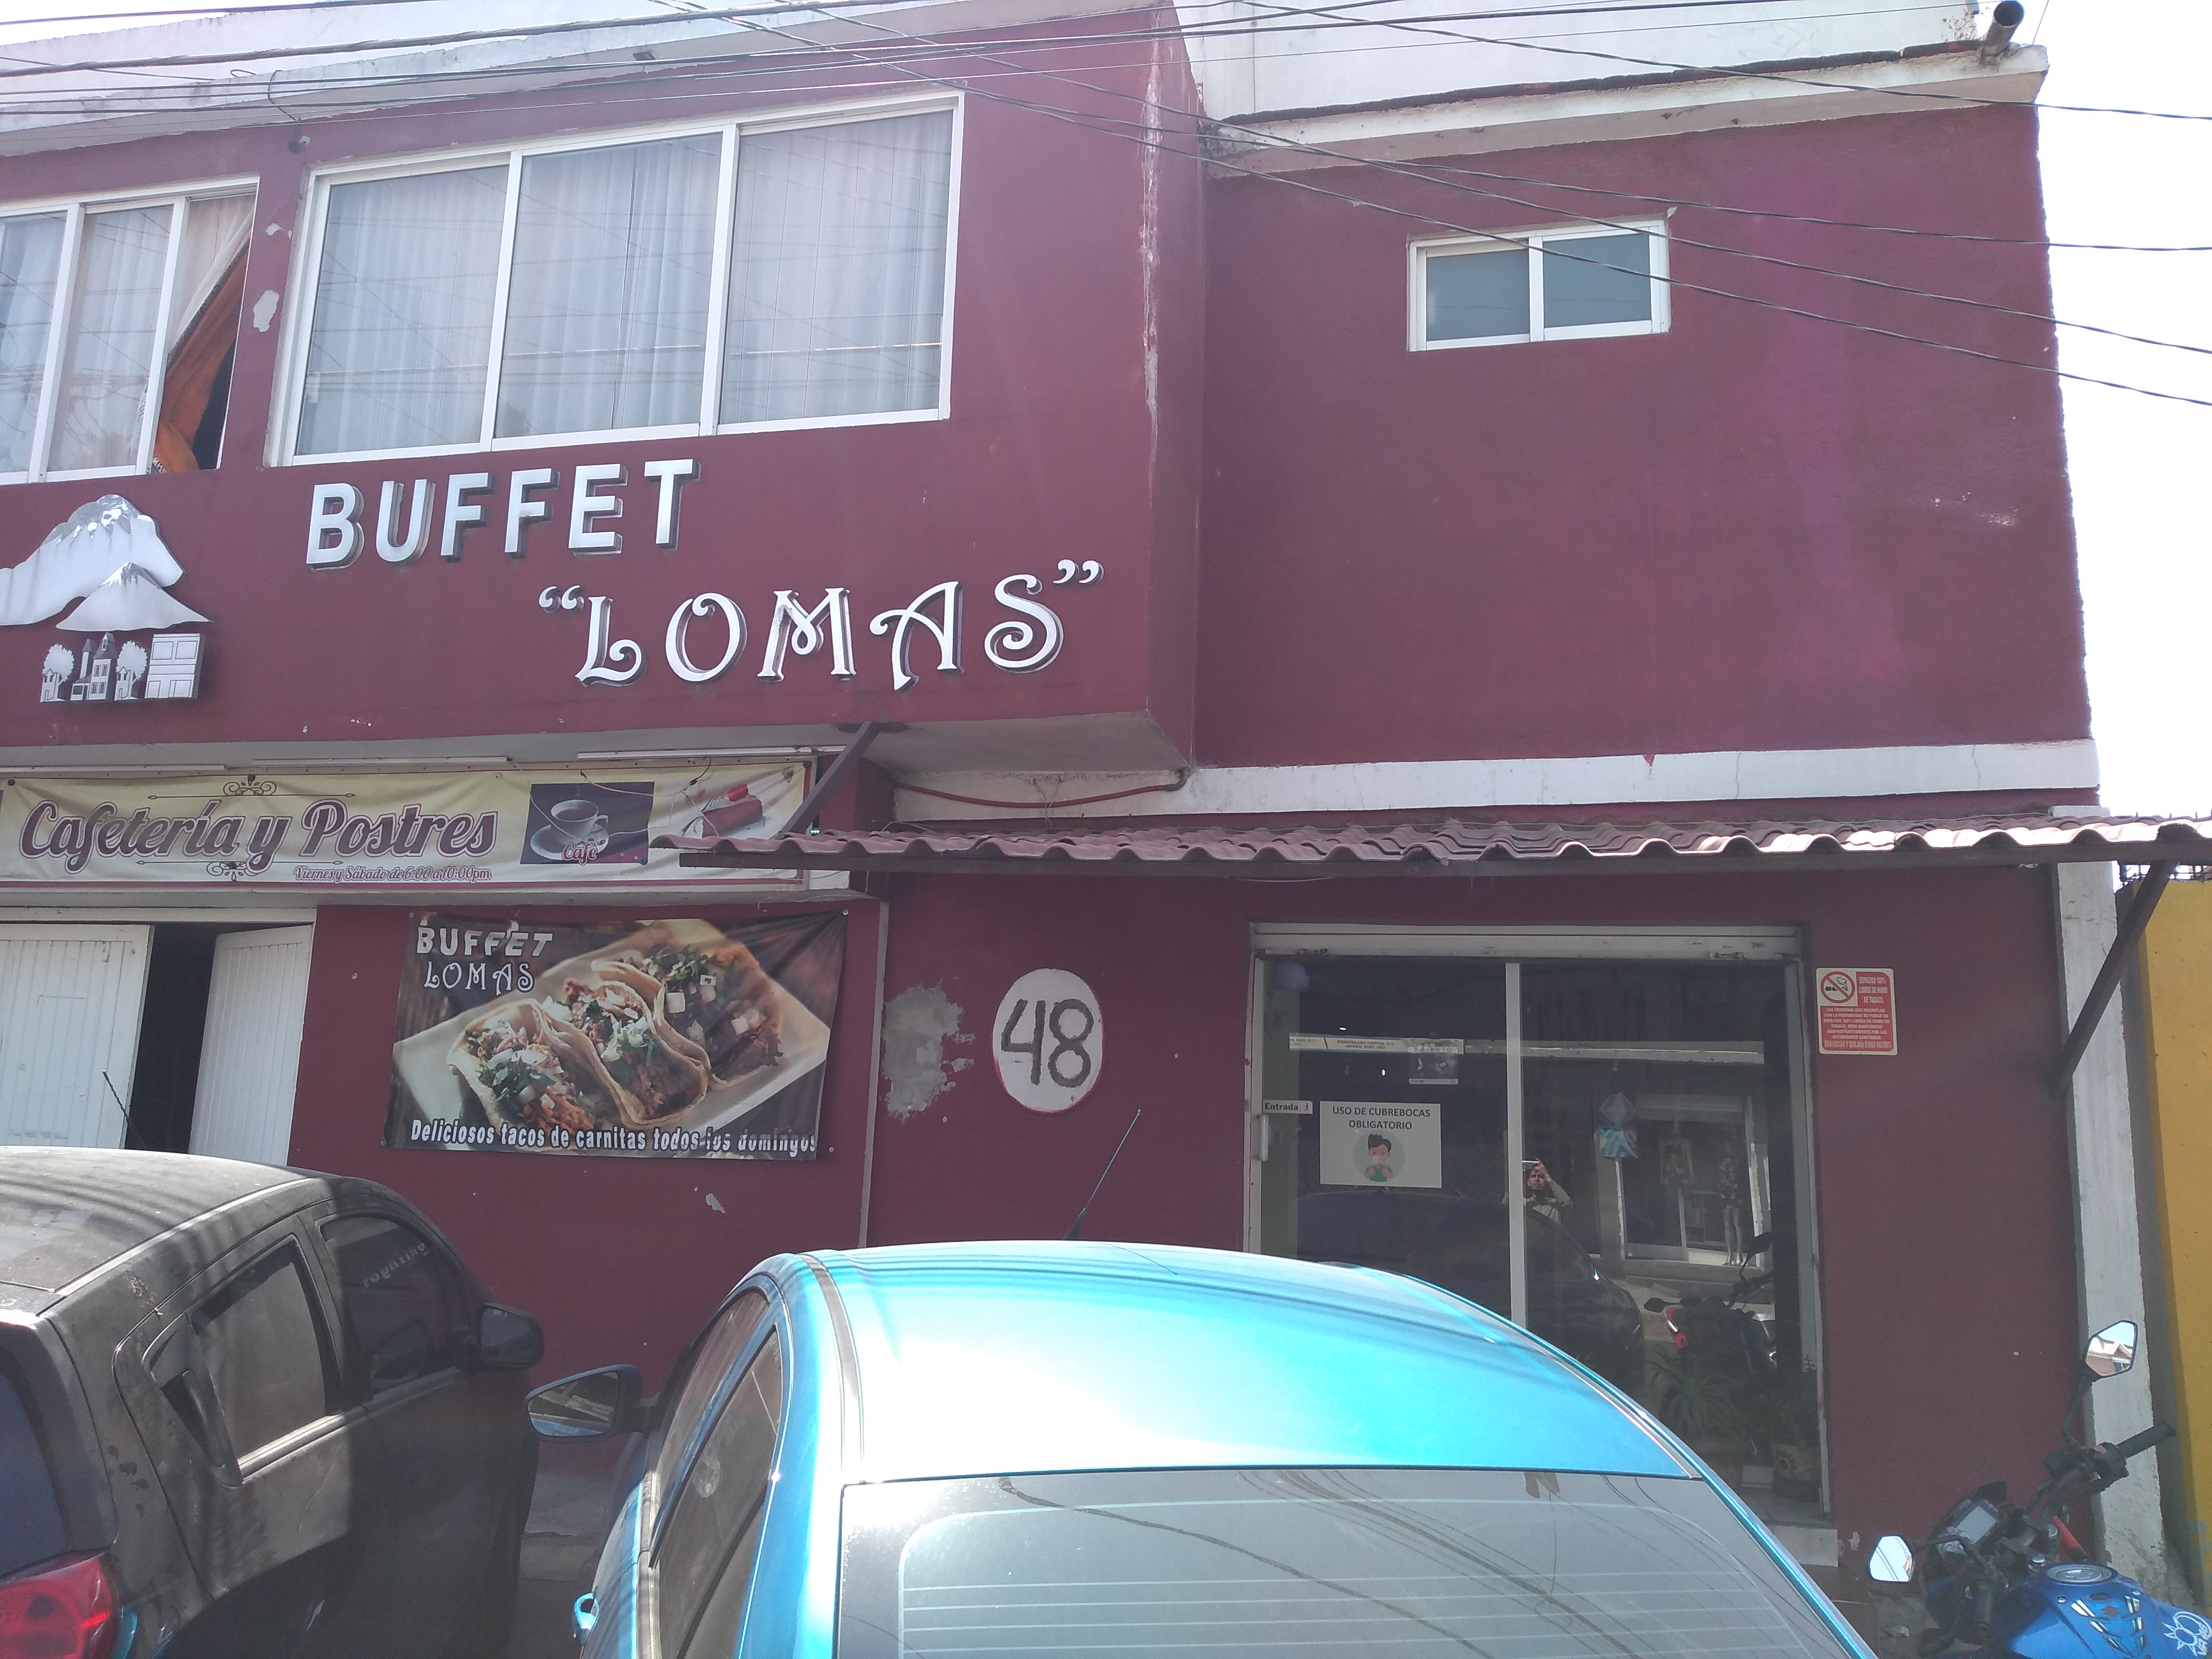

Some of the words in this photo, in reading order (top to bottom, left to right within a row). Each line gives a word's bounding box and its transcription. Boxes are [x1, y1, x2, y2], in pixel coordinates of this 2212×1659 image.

[306, 458, 701, 569] BUFFET
[20, 799, 245, 874] Cafetería
[245, 815, 293, 874] y
[300, 799, 498, 858] Postres
[562, 842, 598, 865] Café
[294, 866, 334, 881] Viernes
[333, 869, 343, 883] y
[345, 866, 388, 881] Sábado
[388, 867, 404, 881] de
[404, 866, 431, 881] 6:00
[432, 869, 442, 881] a
[442, 866, 492, 884] 10:00pm
[417, 927, 553, 956] BUFFET
[424, 961, 534, 996] LOMAS
[1001, 998, 1094, 1088] 48
[1333, 1106, 1352, 1115] USO
[1354, 1107, 1366, 1115] DE
[1369, 1107, 1430, 1118] CUBREBOCAS
[1348, 1119, 1412, 1130] OBLIGATORIO
[410, 1119, 495, 1144] Deliciosos
[500, 1123, 544, 1147] tacos
[550, 1125, 569, 1148] de
[576, 1126, 646, 1150] carnitas
[653, 1127, 700, 1151] todos
[706, 1126, 731, 1151] los
[738, 1128, 816, 1158] domingos
